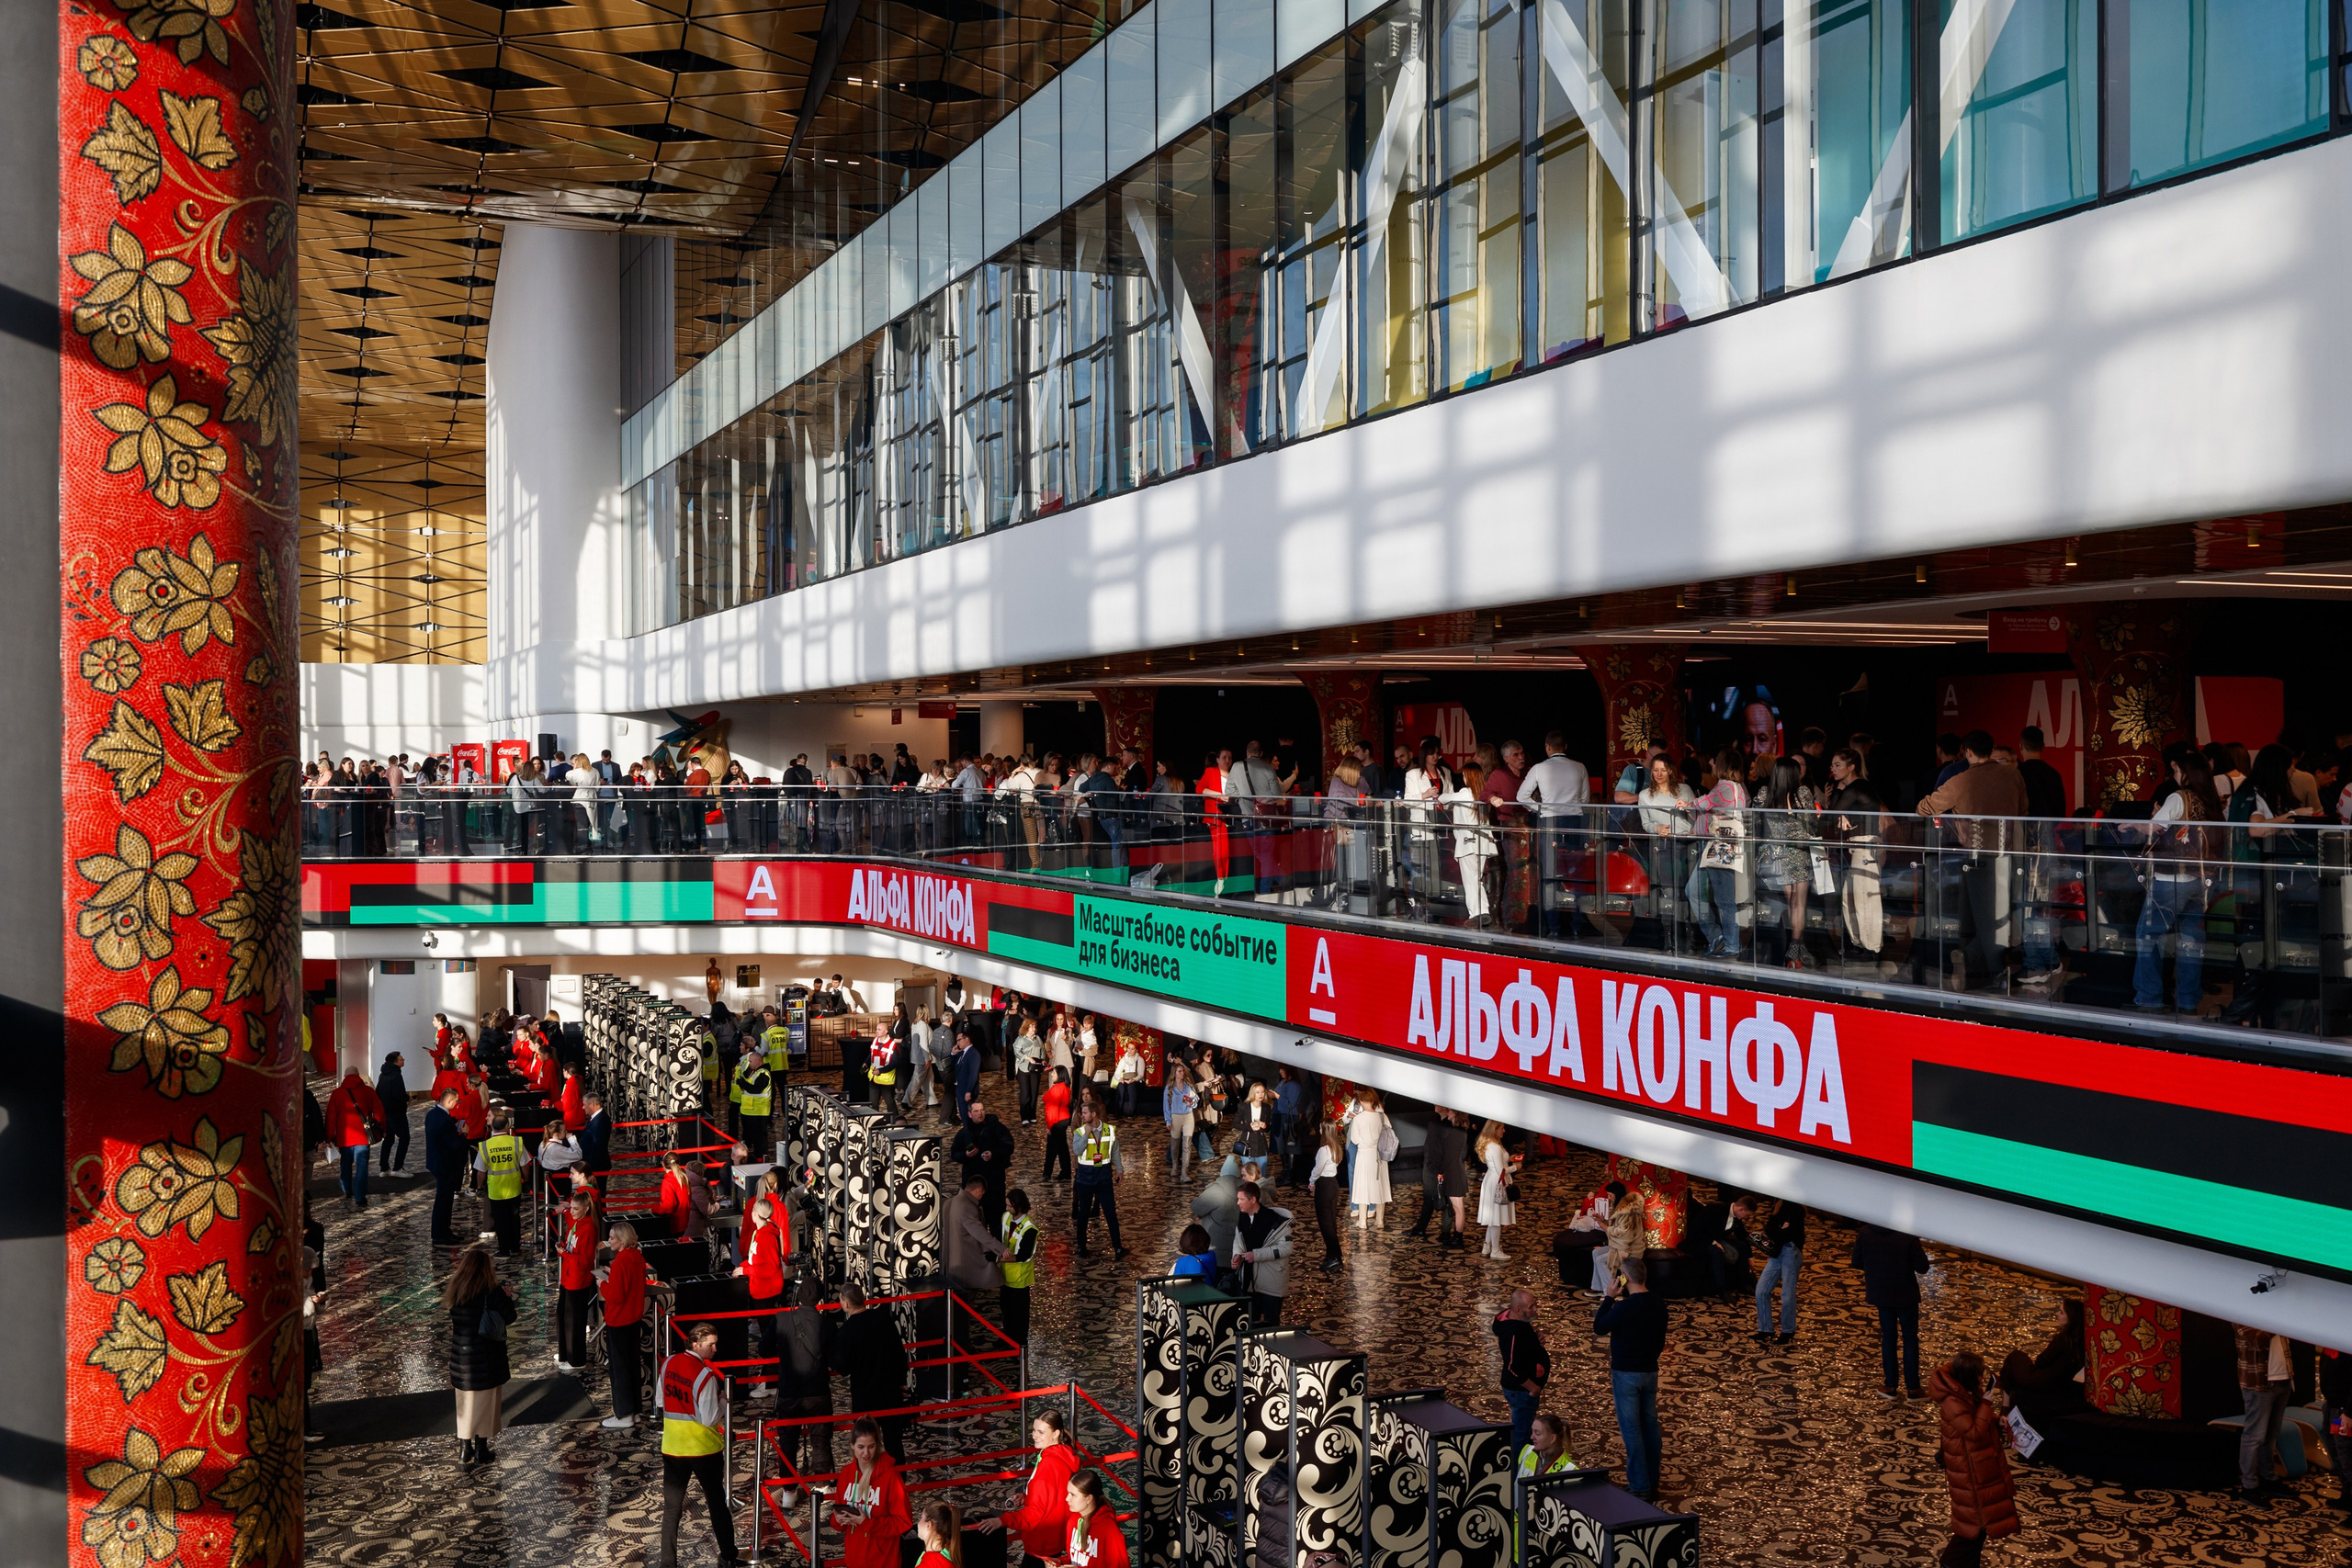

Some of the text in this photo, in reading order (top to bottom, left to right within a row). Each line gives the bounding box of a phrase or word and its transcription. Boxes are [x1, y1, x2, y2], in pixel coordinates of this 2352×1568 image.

[847, 868, 976, 944] АЛЬФА КОНФА
[1079, 938, 1181, 982] для бизнеса
[1080, 902, 1277, 965] Масштабное событие
[1407, 953, 1852, 1145] АЛЬФА КОНФА
[489, 1145, 513, 1154] STEWARD
[491, 1154, 513, 1164] 0156
